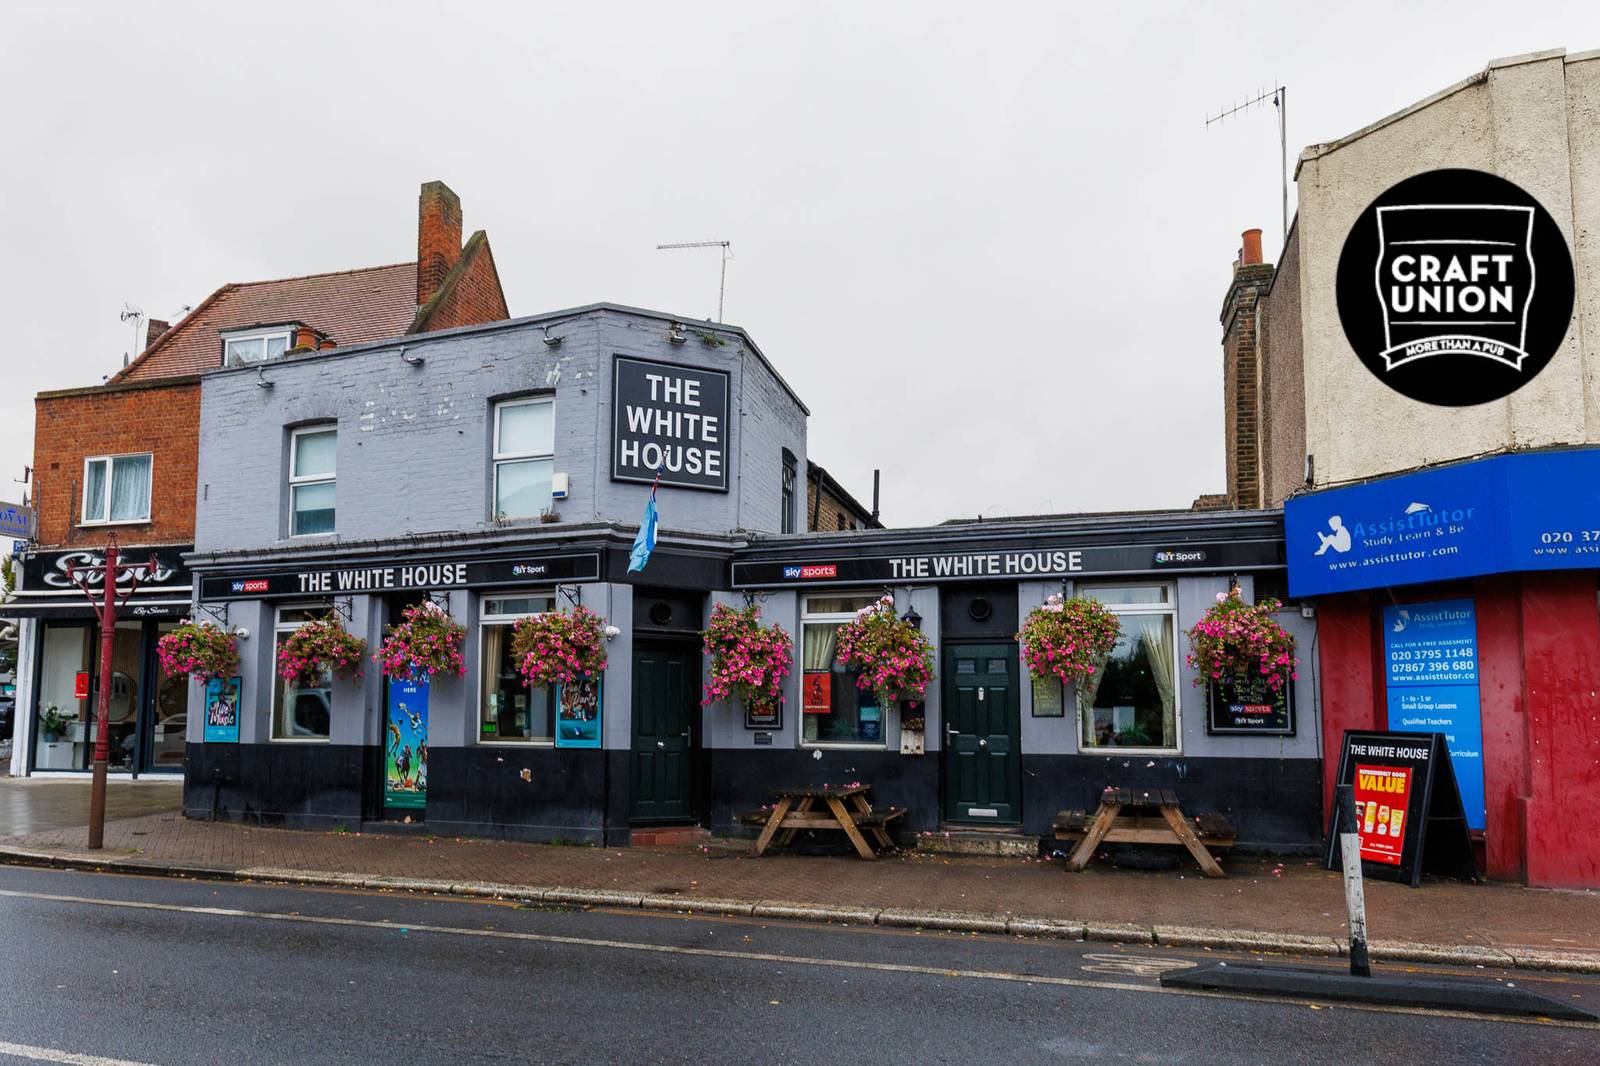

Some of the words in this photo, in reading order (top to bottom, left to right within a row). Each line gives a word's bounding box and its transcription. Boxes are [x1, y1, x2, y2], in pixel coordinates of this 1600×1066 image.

[645, 373, 701, 407] THE
[626, 405, 718, 443] WHITE
[620, 439, 721, 477] HOUSE
[1353, 507, 1476, 539] AssistTutor
[1541, 532, 1573, 544] 020
[1176, 552, 1201, 561] Sport
[1329, 546, 1458, 571] www.assisttutor.com
[527, 565, 545, 575] Sport
[785, 569, 800, 577] sky
[803, 566, 835, 577] sports
[889, 559, 929, 577] THE
[933, 555, 1000, 575] WHITE
[1005, 552, 1082, 573] HOUSE
[299, 573, 332, 592] THE
[337, 568, 394, 589] WHITE
[402, 564, 467, 587] HOUSE
[232, 582, 244, 592] sky
[245, 581, 268, 591] sports
[1414, 611, 1472, 622] AssistTutor
[1391, 651, 1412, 661] 020
[1414, 649, 1442, 660] 3795
[1445, 648, 1473, 658] 1148
[1392, 663, 1425, 673] 07867
[1428, 662, 1449, 672] 396
[1452, 661, 1474, 671] 680
[1230, 705, 1243, 713] sky
[1245, 704, 1271, 713] sports
[1350, 744, 1366, 756] THE
[1368, 746, 1395, 758] WHITE
[1396, 748, 1429, 760] HOUSE
[1359, 774, 1405, 794] VALUE
